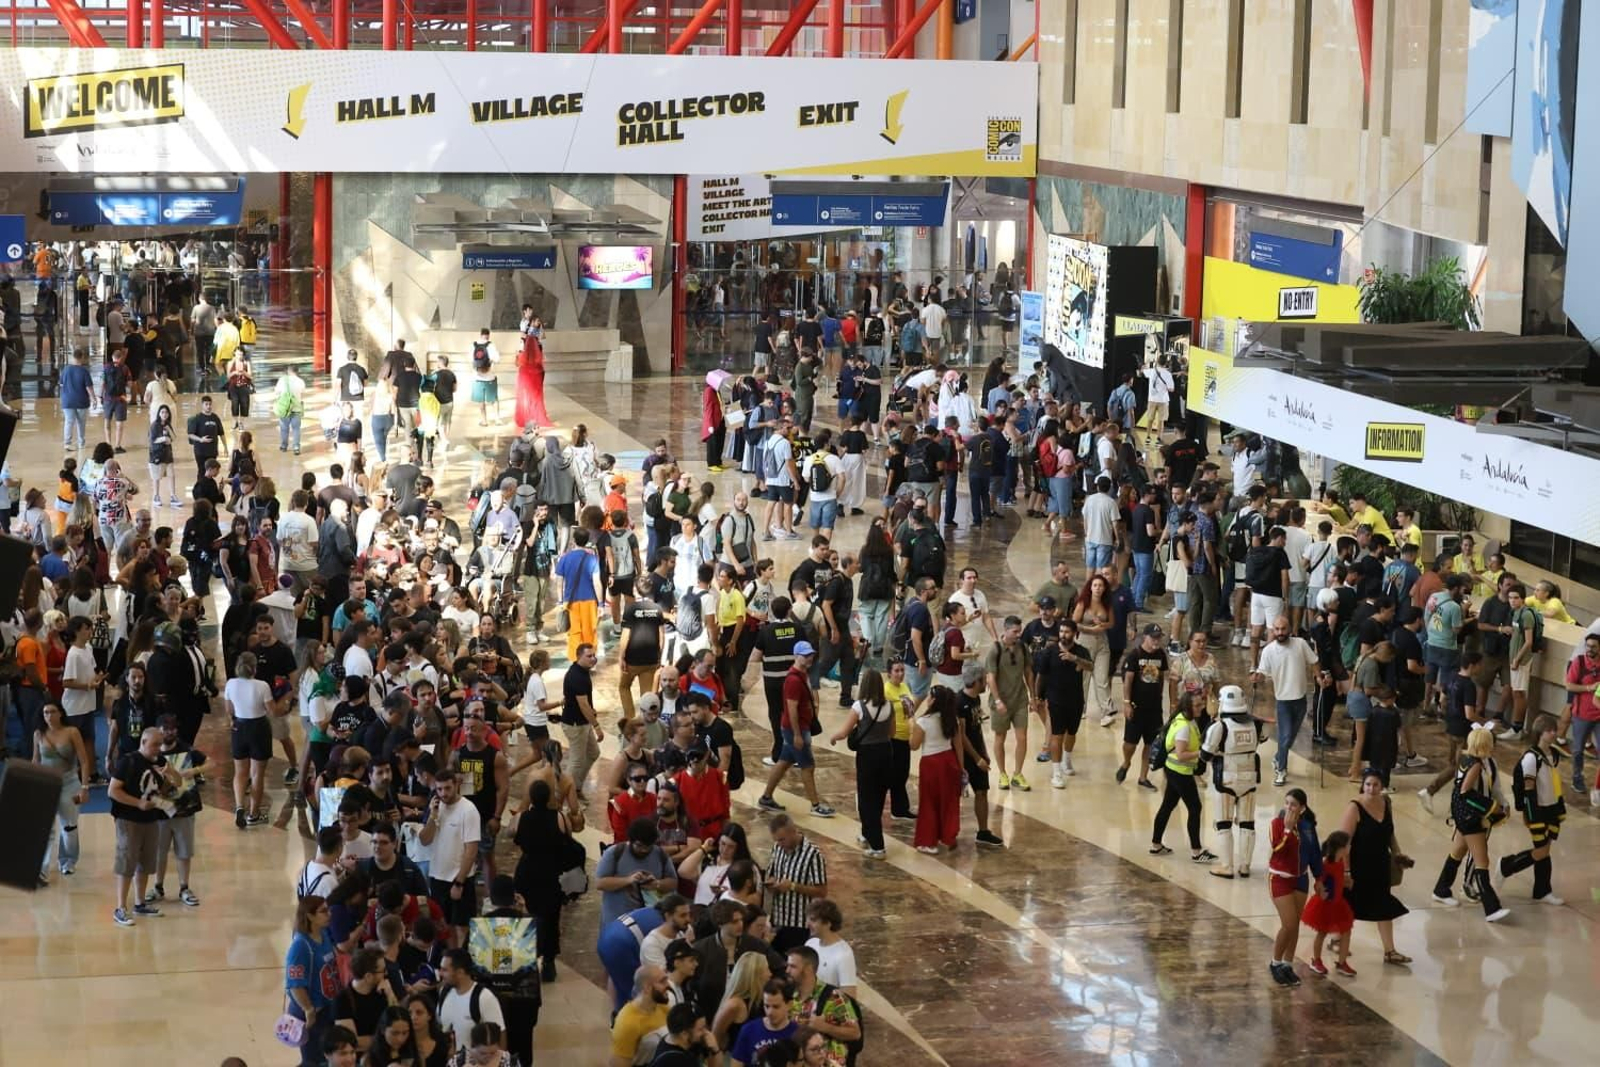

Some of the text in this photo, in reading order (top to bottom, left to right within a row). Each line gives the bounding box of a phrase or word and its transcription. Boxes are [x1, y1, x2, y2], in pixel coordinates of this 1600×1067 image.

[38, 75, 176, 121] WELCOME
[337, 92, 436, 122] HALL M
[471, 92, 583, 123] VILLAGE
[618, 92, 765, 125] COLLECTOR
[799, 101, 859, 126] EXIT
[619, 121, 684, 146] HALL
[988, 121, 999, 154] COMIC
[1000, 121, 1021, 132] CON
[703, 177, 739, 188] HALL M
[702, 201, 730, 211] MEET
[732, 199, 752, 208] THE
[703, 188, 745, 200] VILLAGE
[702, 209, 757, 222] COLLECTOR
[702, 224, 725, 234] EXIT
[544, 257, 551, 267] A
[1284, 291, 1314, 311] NO ENTRY
[1370, 428, 1422, 452] INFORMATION
